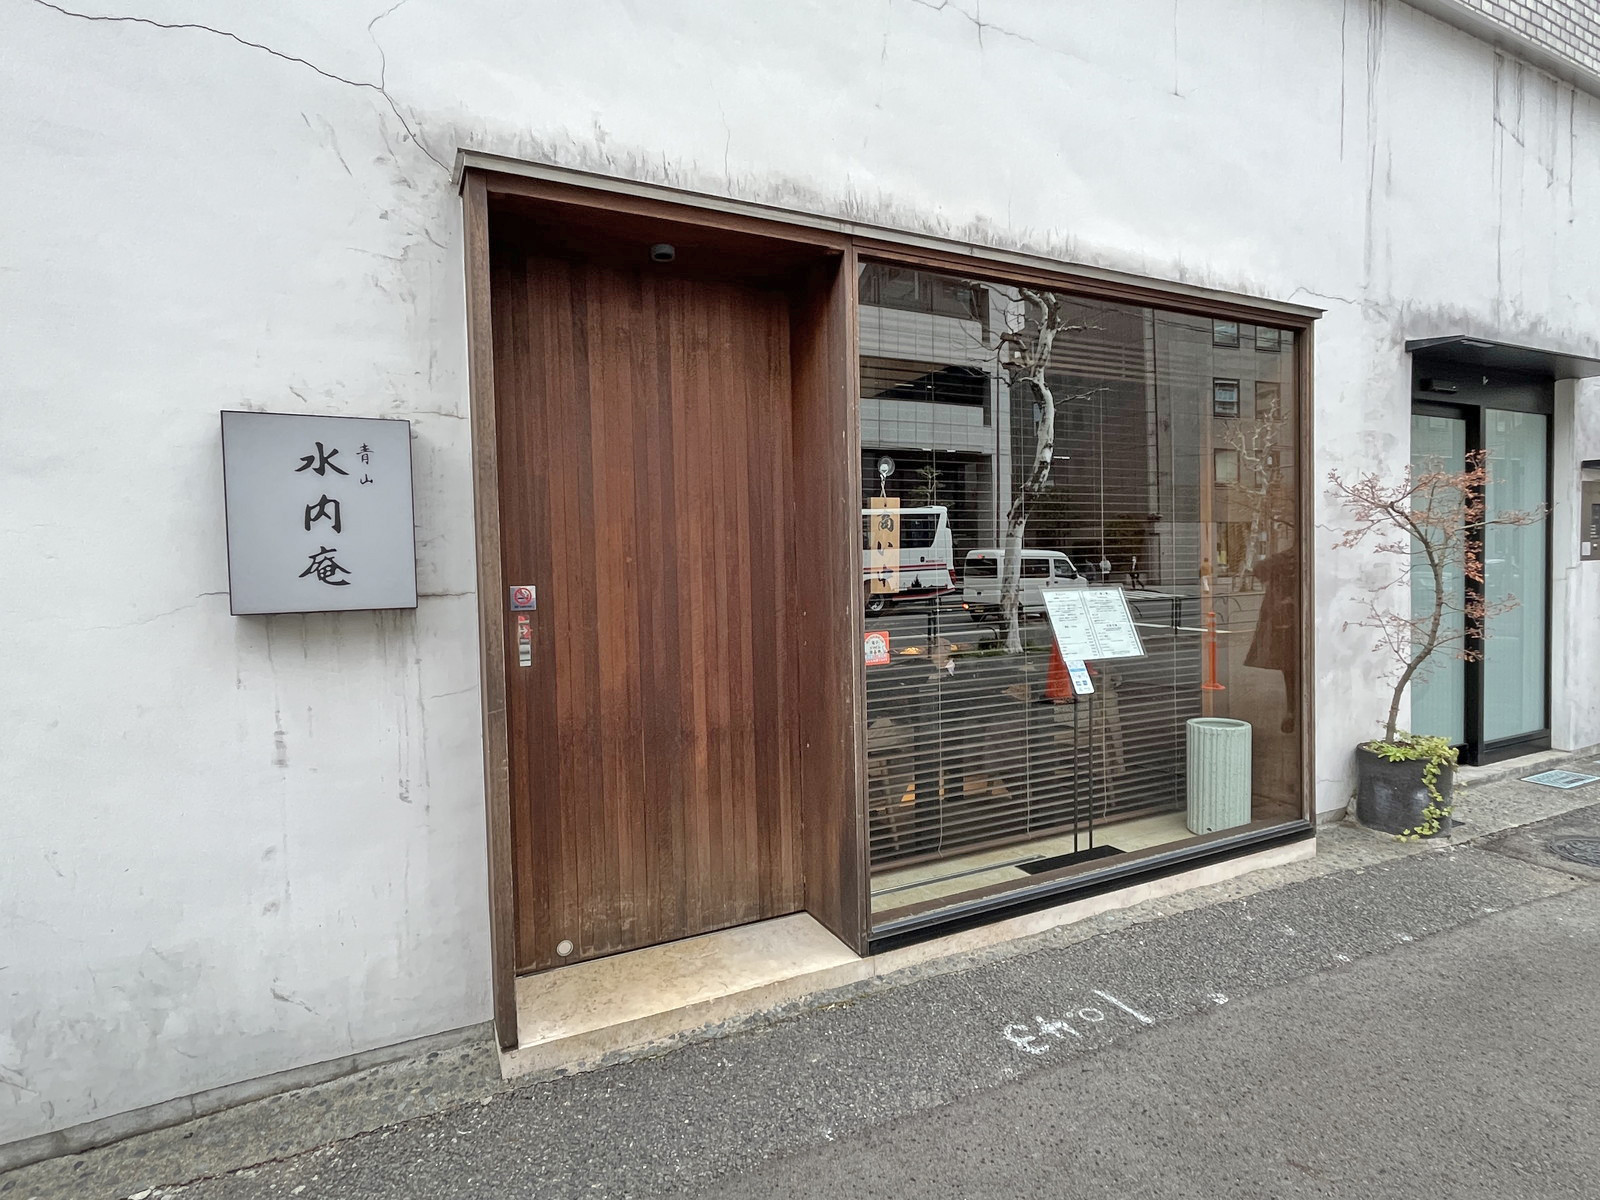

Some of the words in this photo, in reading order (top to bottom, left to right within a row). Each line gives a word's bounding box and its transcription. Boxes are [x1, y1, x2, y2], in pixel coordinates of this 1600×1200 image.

[356, 443, 374, 485] 青山
[294, 441, 352, 586] 水内庵
